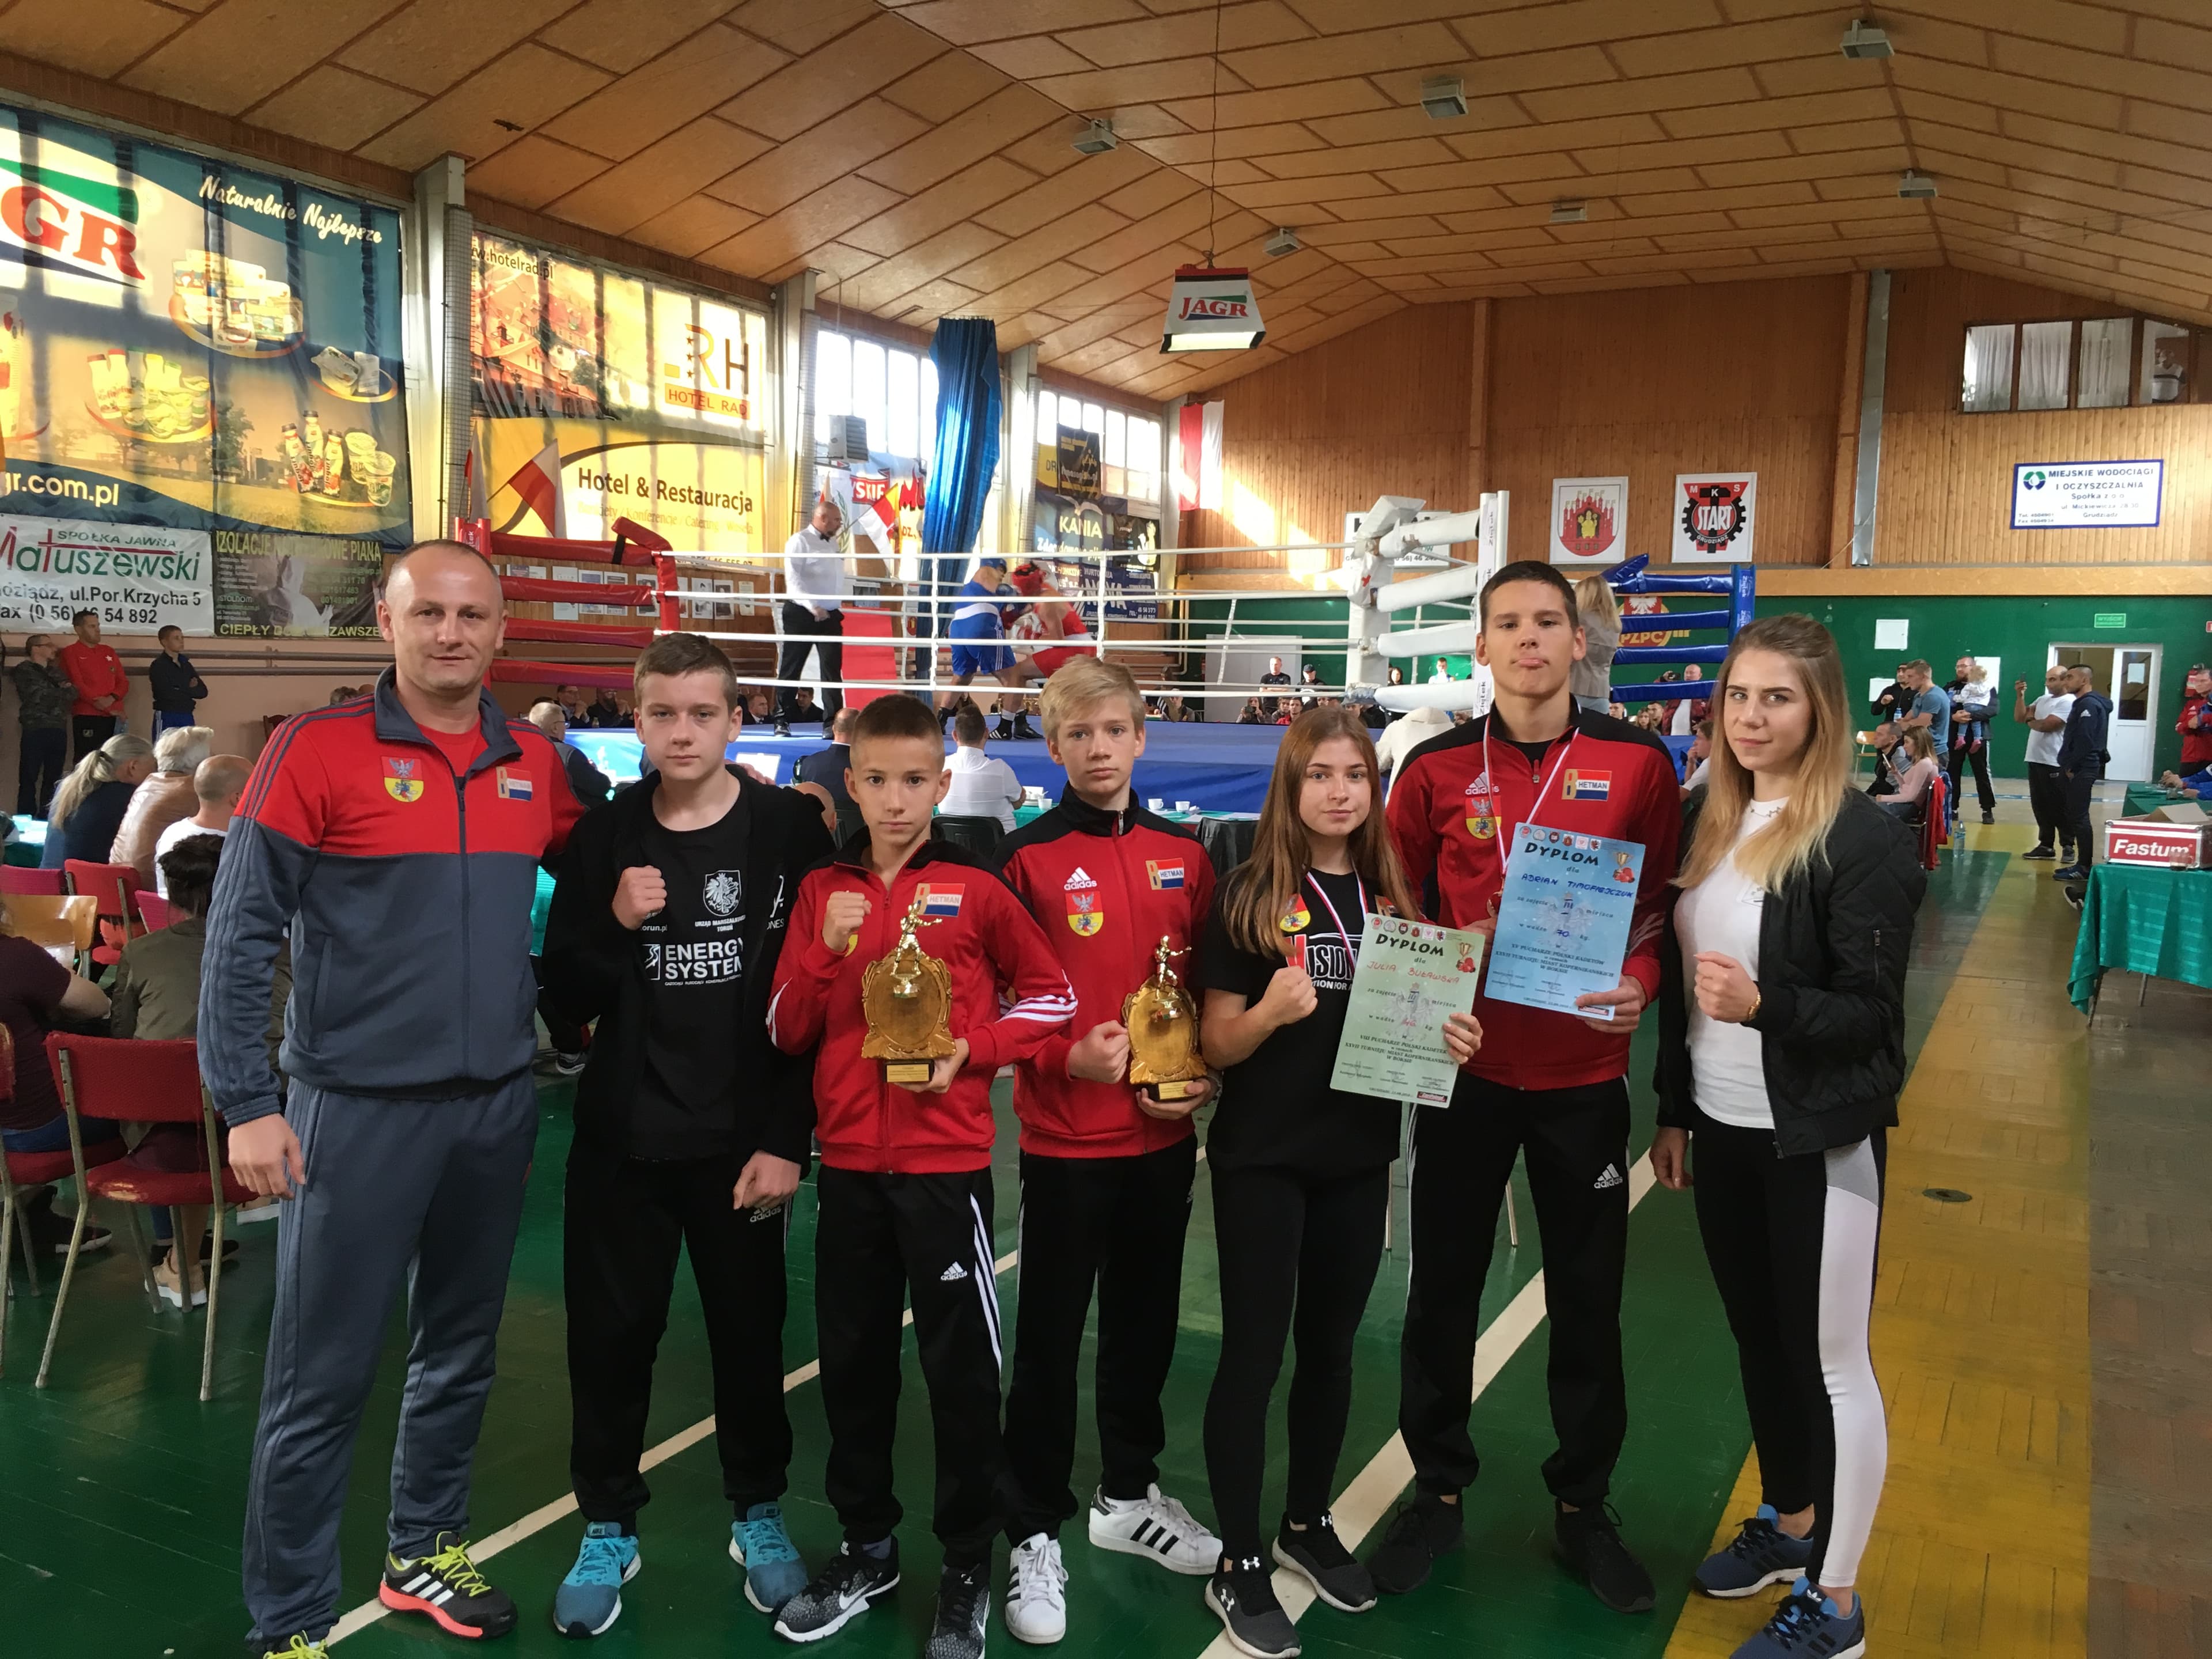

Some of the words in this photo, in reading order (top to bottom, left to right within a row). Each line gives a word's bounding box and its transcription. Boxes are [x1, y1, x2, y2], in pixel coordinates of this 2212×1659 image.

[199, 175, 297, 221] Naturalnie
[303, 203, 382, 245] Najlepsze
[1179, 296, 1249, 321] JAGR
[669, 388, 715, 411] HOTEL
[721, 400, 748, 417] RAD
[2048, 469, 2094, 478] MIEJSKIE
[578, 467, 629, 495] Hotel
[637, 476, 650, 498] &
[657, 479, 753, 516] Restauracja
[2063, 482, 2143, 490] OCZYSZCZALNIA
[1698, 505, 1732, 531] START
[125, 536, 177, 548] JAWNA
[216, 530, 271, 555] IZOLACJE
[70, 586, 188, 608] ul.Por.Krzycha
[192, 592, 201, 606] 5
[0, 604, 22, 619] ax
[105, 608, 124, 623] 54
[129, 609, 158, 624] 892
[219, 623, 270, 636] CIEPŁY
[329, 626, 381, 637] ZAWSZE
[1578, 781, 1608, 789] HETMAN
[1524, 842, 1599, 866] DYPLOM
[2113, 839, 2190, 857] Fastum
[1160, 869, 1184, 878] HETMAN
[1566, 866, 1580, 874] dla
[1063, 880, 1097, 891] adidas
[1521, 873, 1559, 886] ADRIAN
[929, 895, 960, 904] HETMAN
[1556, 929, 1570, 938] 70
[1376, 933, 1444, 956] DYPLOM
[1366, 960, 1397, 972] JULIA
[1594, 1176, 1623, 1189] adidas
[749, 1206, 782, 1223] adidas
[940, 1270, 968, 1282] adidas
